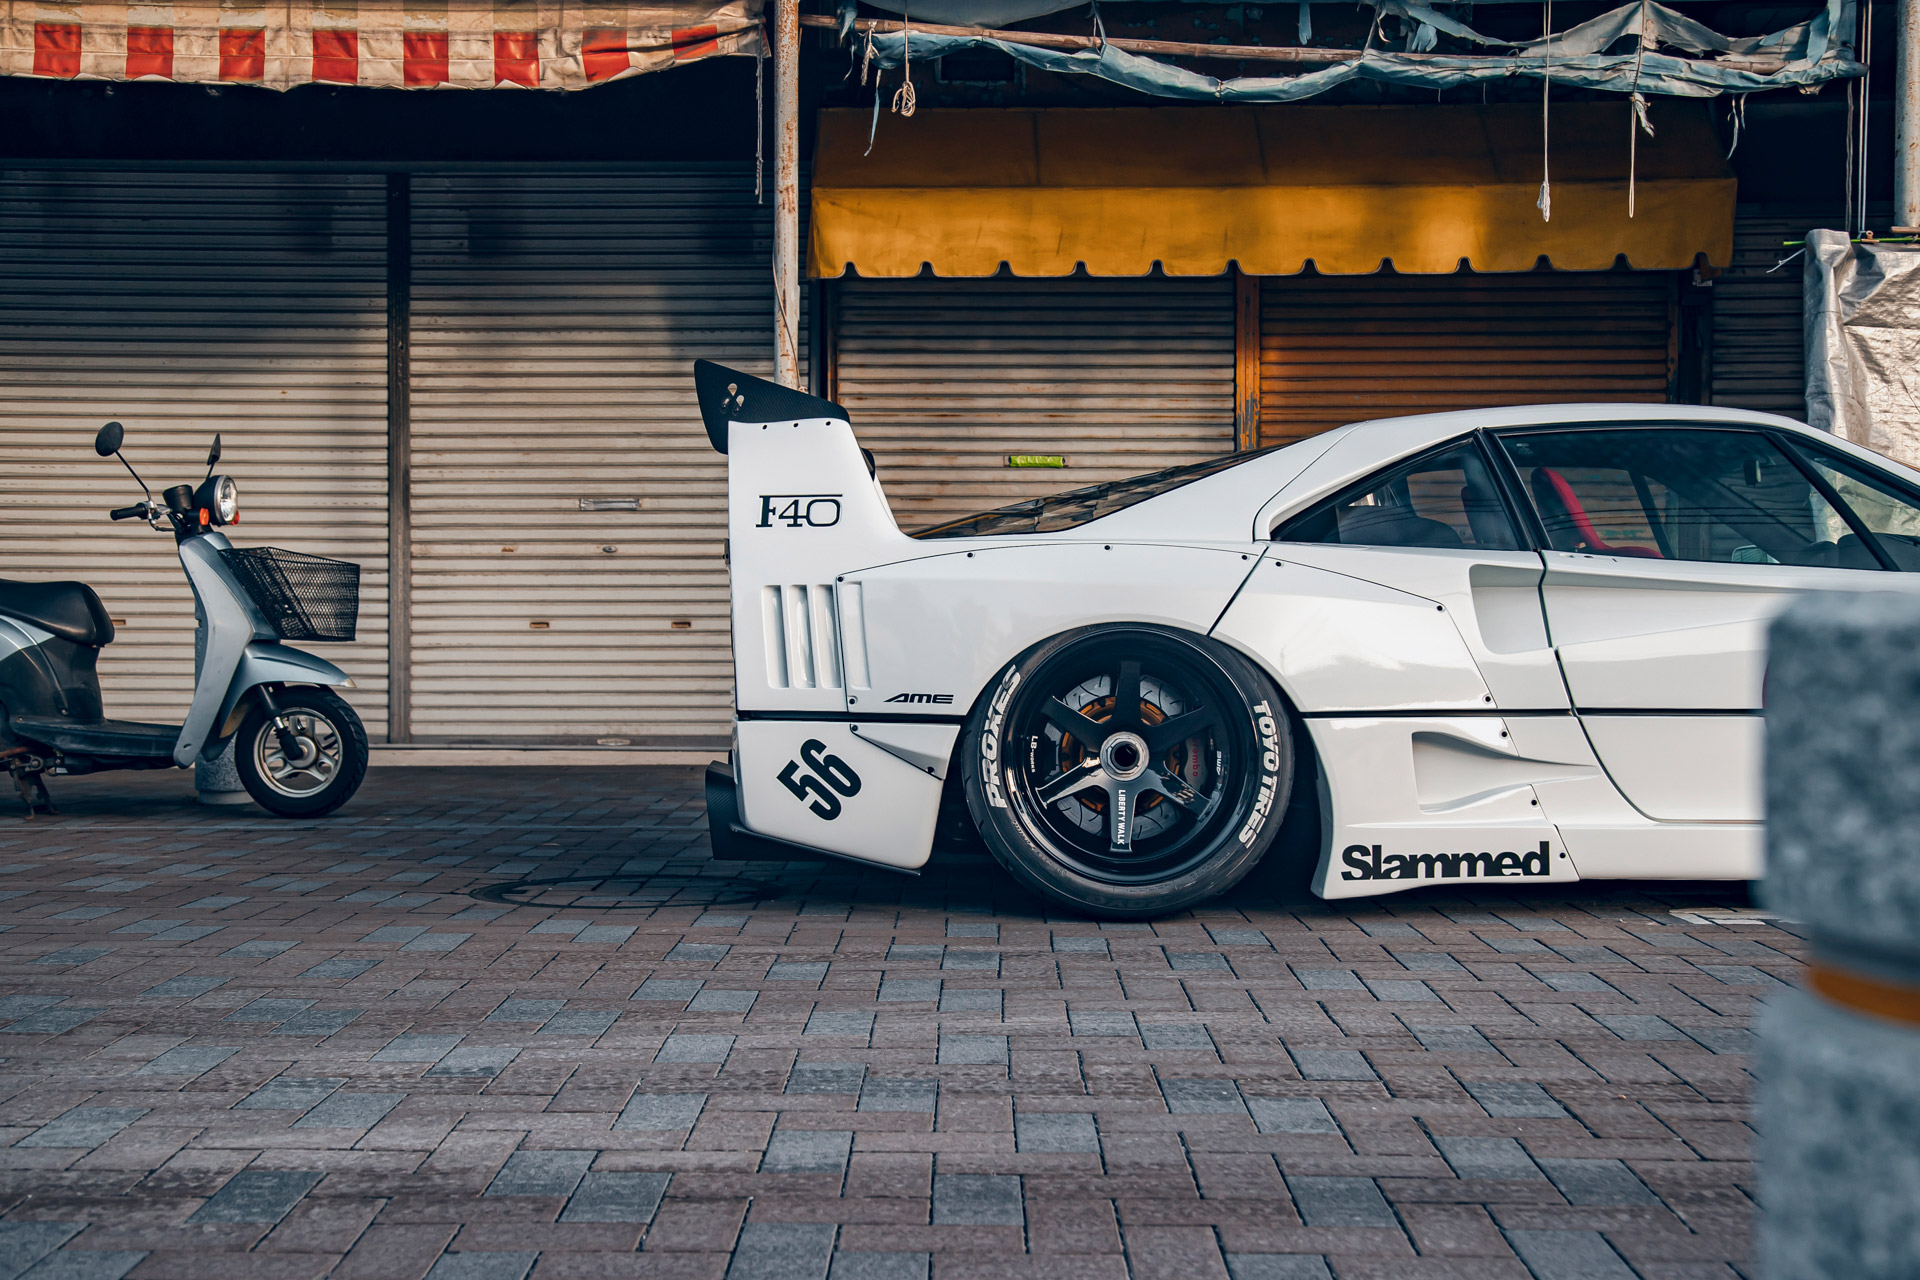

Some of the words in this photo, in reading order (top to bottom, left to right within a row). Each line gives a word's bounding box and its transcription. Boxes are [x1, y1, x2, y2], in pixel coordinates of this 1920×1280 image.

[755, 494, 843, 528] F40
[883, 693, 954, 704] AME
[982, 664, 1021, 808] PROXES
[1253, 700, 1280, 772] TOYO
[776, 738, 862, 821] 56
[1118, 789, 1127, 822] LIBERTY
[1238, 775, 1278, 849] TIRES
[1117, 822, 1126, 845] WALK
[1341, 841, 1550, 881] Slammed
